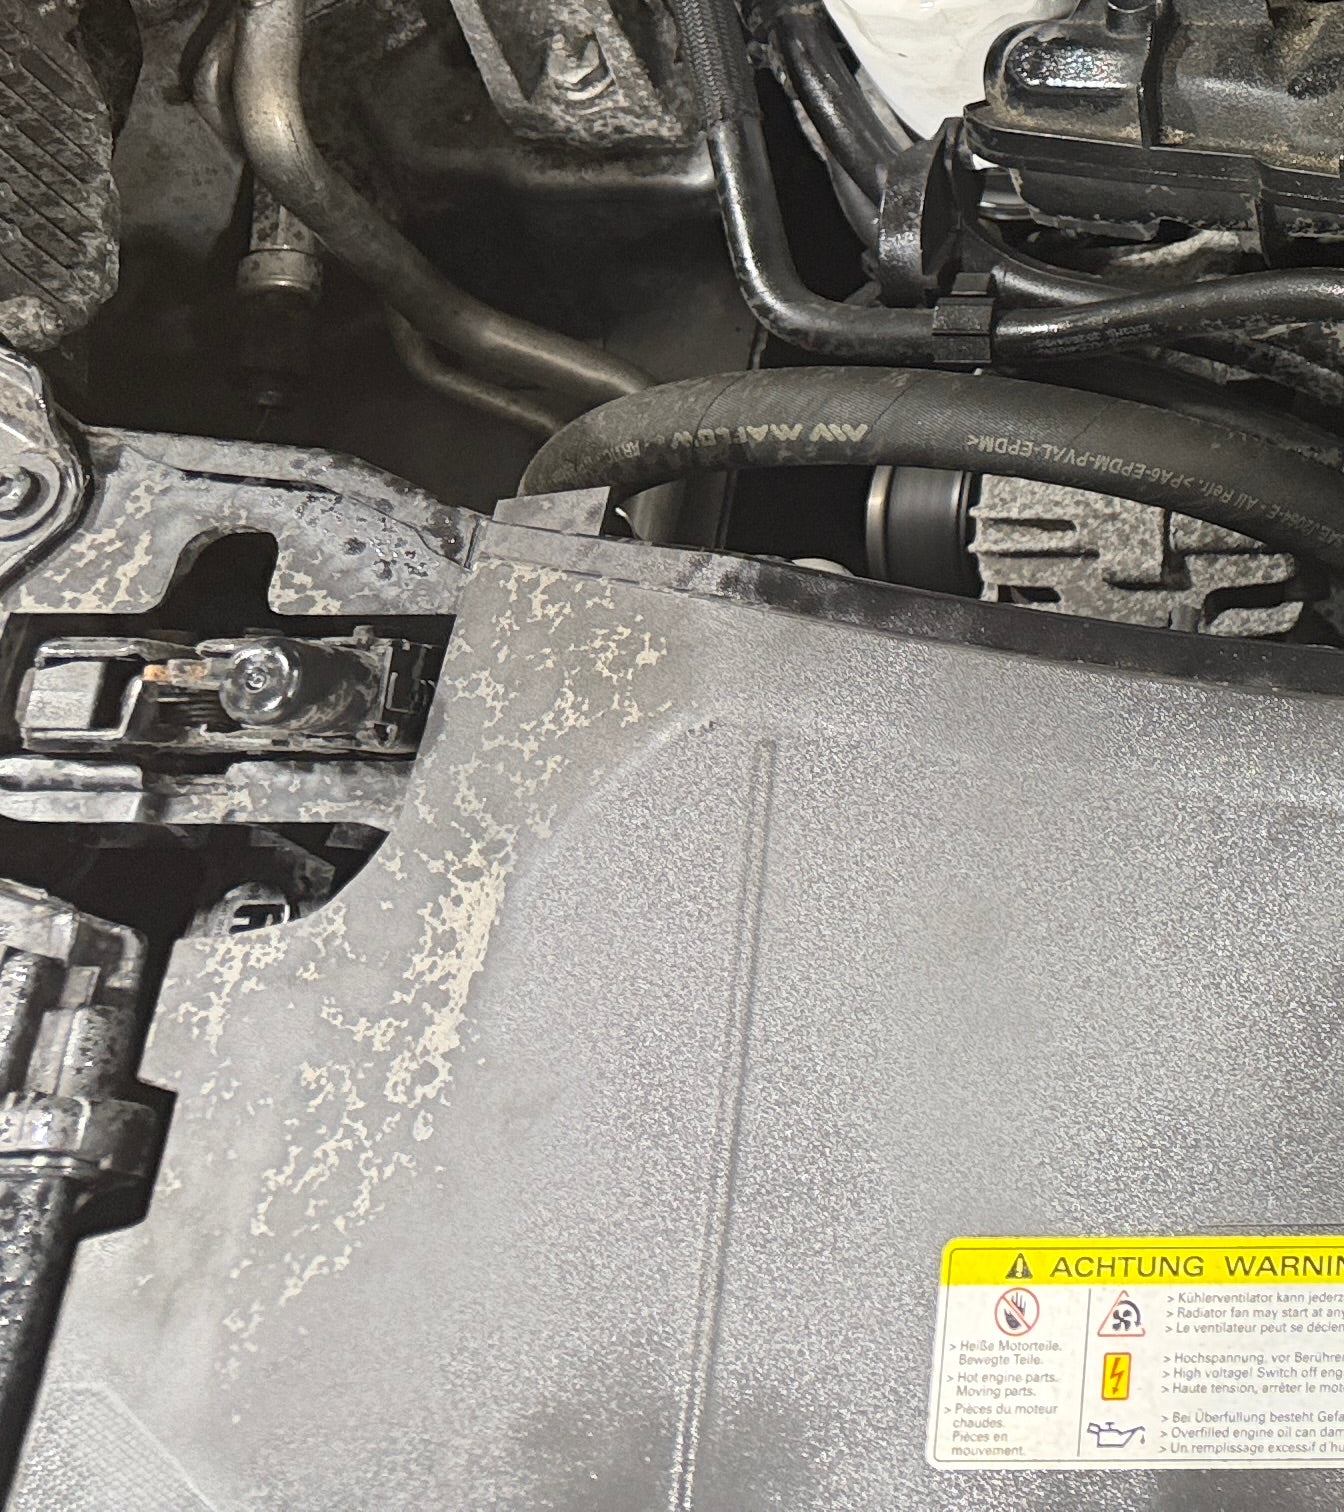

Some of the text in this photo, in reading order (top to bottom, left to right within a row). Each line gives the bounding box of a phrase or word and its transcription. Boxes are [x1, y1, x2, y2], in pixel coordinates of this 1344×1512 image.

[1049, 1256, 1205, 1277] ACHTUNG
[1178, 1292, 1273, 1304] Kühlerventilator
[1277, 1292, 1304, 1303] kann
[1177, 1307, 1227, 1318] Radiator
[1231, 1307, 1249, 1318] fan
[1253, 1309, 1278, 1320] may
[1282, 1309, 1308, 1318] start
[1312, 1309, 1323, 1318] at
[1176, 1323, 1190, 1333] Le
[1194, 1322, 1256, 1333] ventilateur
[1260, 1323, 1286, 1335] peut
[1291, 1324, 1303, 1333] se
[960, 1340, 1062, 1352] Heiße Motorteile.
[959, 1354, 1043, 1366] Bewegte Teile.
[1272, 1354, 1290, 1363] vor
[958, 1372, 1059, 1384] Hot engine parts.
[1174, 1368, 1201, 1380] High
[1205, 1368, 1252, 1380] voltage!
[1257, 1367, 1297, 1378] Switch
[1301, 1367, 1317, 1378] off
[956, 1387, 1035, 1398] Moving parts.
[1173, 1383, 1207, 1393] Haute
[1211, 1383, 1258, 1395] tension,
[1262, 1382, 1302, 1393] arrêter
[1306, 1383, 1316, 1393] le
[955, 1403, 1057, 1414] Pièces moteur
[953, 1418, 1005, 1428] chaudes.
[1173, 1412, 1190, 1423] Bei
[1270, 1411, 1313, 1422] besteht
[952, 1431, 1008, 1442] Pièces en
[1171, 1427, 1229, 1438] Overfilled
[1233, 1428, 1273, 1440] engine
[1277, 1427, 1292, 1437] oil
[1295, 1428, 1316, 1437] can
[951, 1446, 1025, 1457] mouvement.
[1170, 1443, 1188, 1453] Un
[1192, 1443, 1264, 1455] remplissage
[1268, 1442, 1315, 1453] excessif
